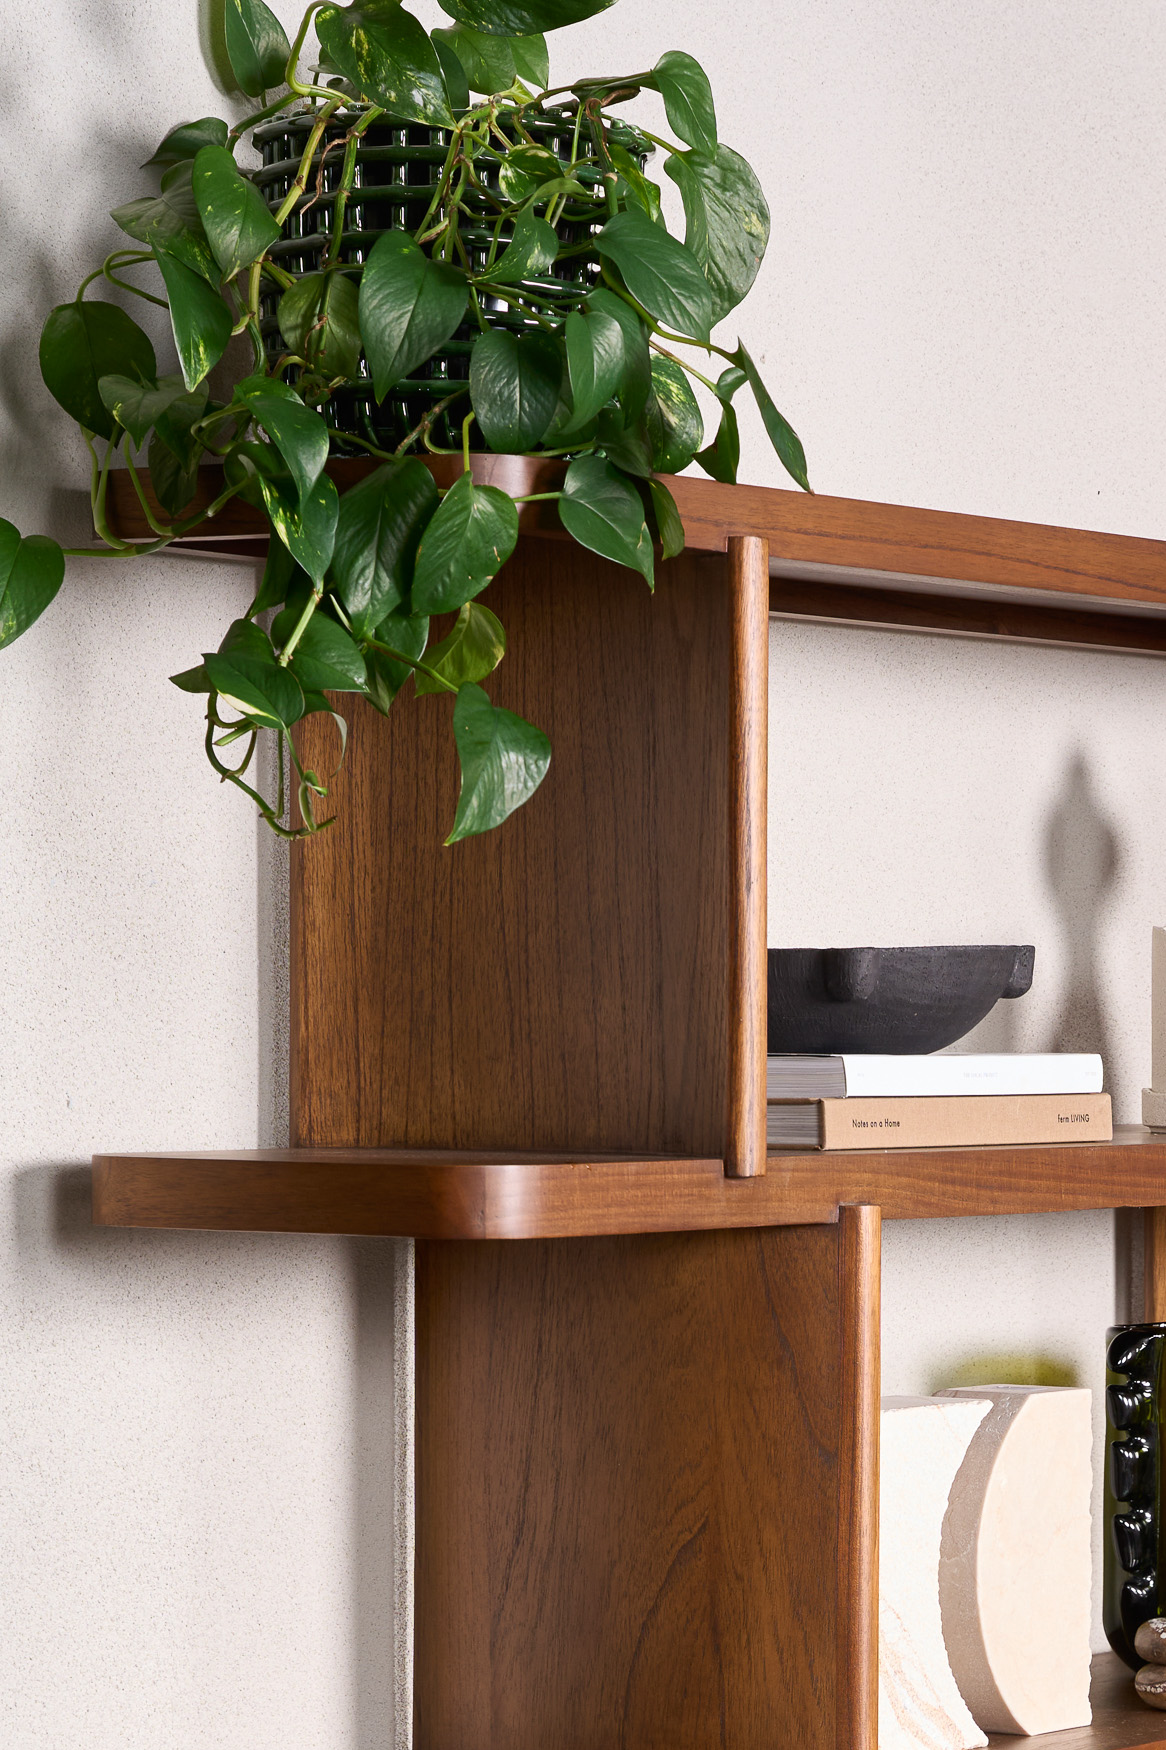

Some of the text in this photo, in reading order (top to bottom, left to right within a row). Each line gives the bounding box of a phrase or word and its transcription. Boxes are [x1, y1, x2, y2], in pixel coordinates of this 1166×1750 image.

[852, 1119, 869, 1128] Notes
[885, 1118, 900, 1127] Home
[1071, 1113, 1090, 1123] LIVING
